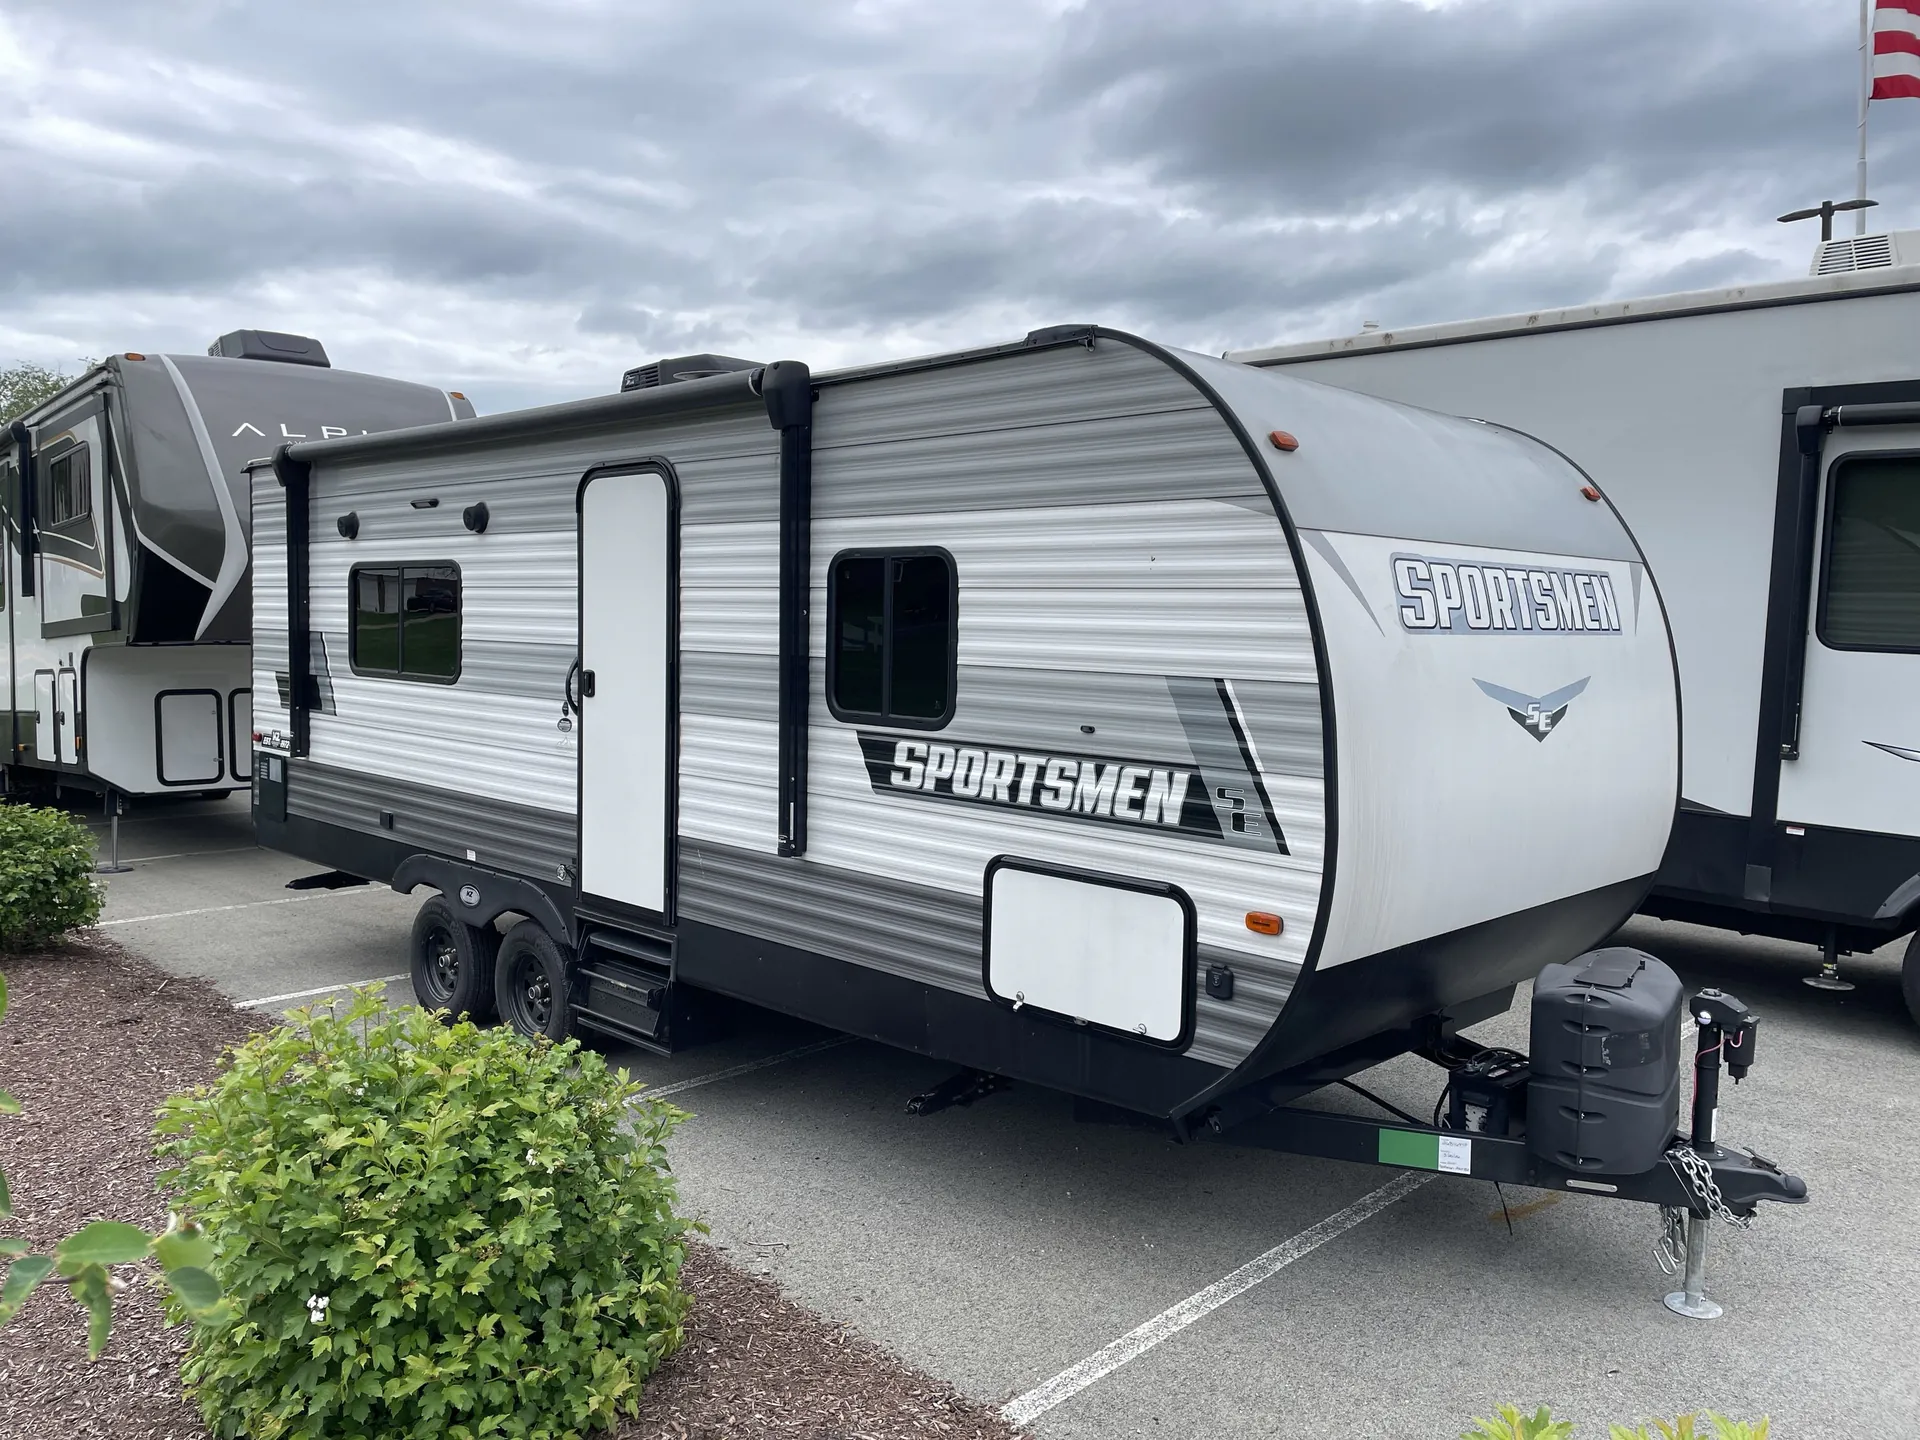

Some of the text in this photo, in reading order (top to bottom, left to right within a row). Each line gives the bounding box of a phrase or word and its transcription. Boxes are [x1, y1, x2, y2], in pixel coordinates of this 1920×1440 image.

[232, 422, 367, 439] ALP
[1393, 558, 1621, 631] SPORTSMEN
[1525, 702, 1553, 733] SE
[890, 740, 1190, 826] SPORTSMEN
[1215, 786, 1261, 836] SE
